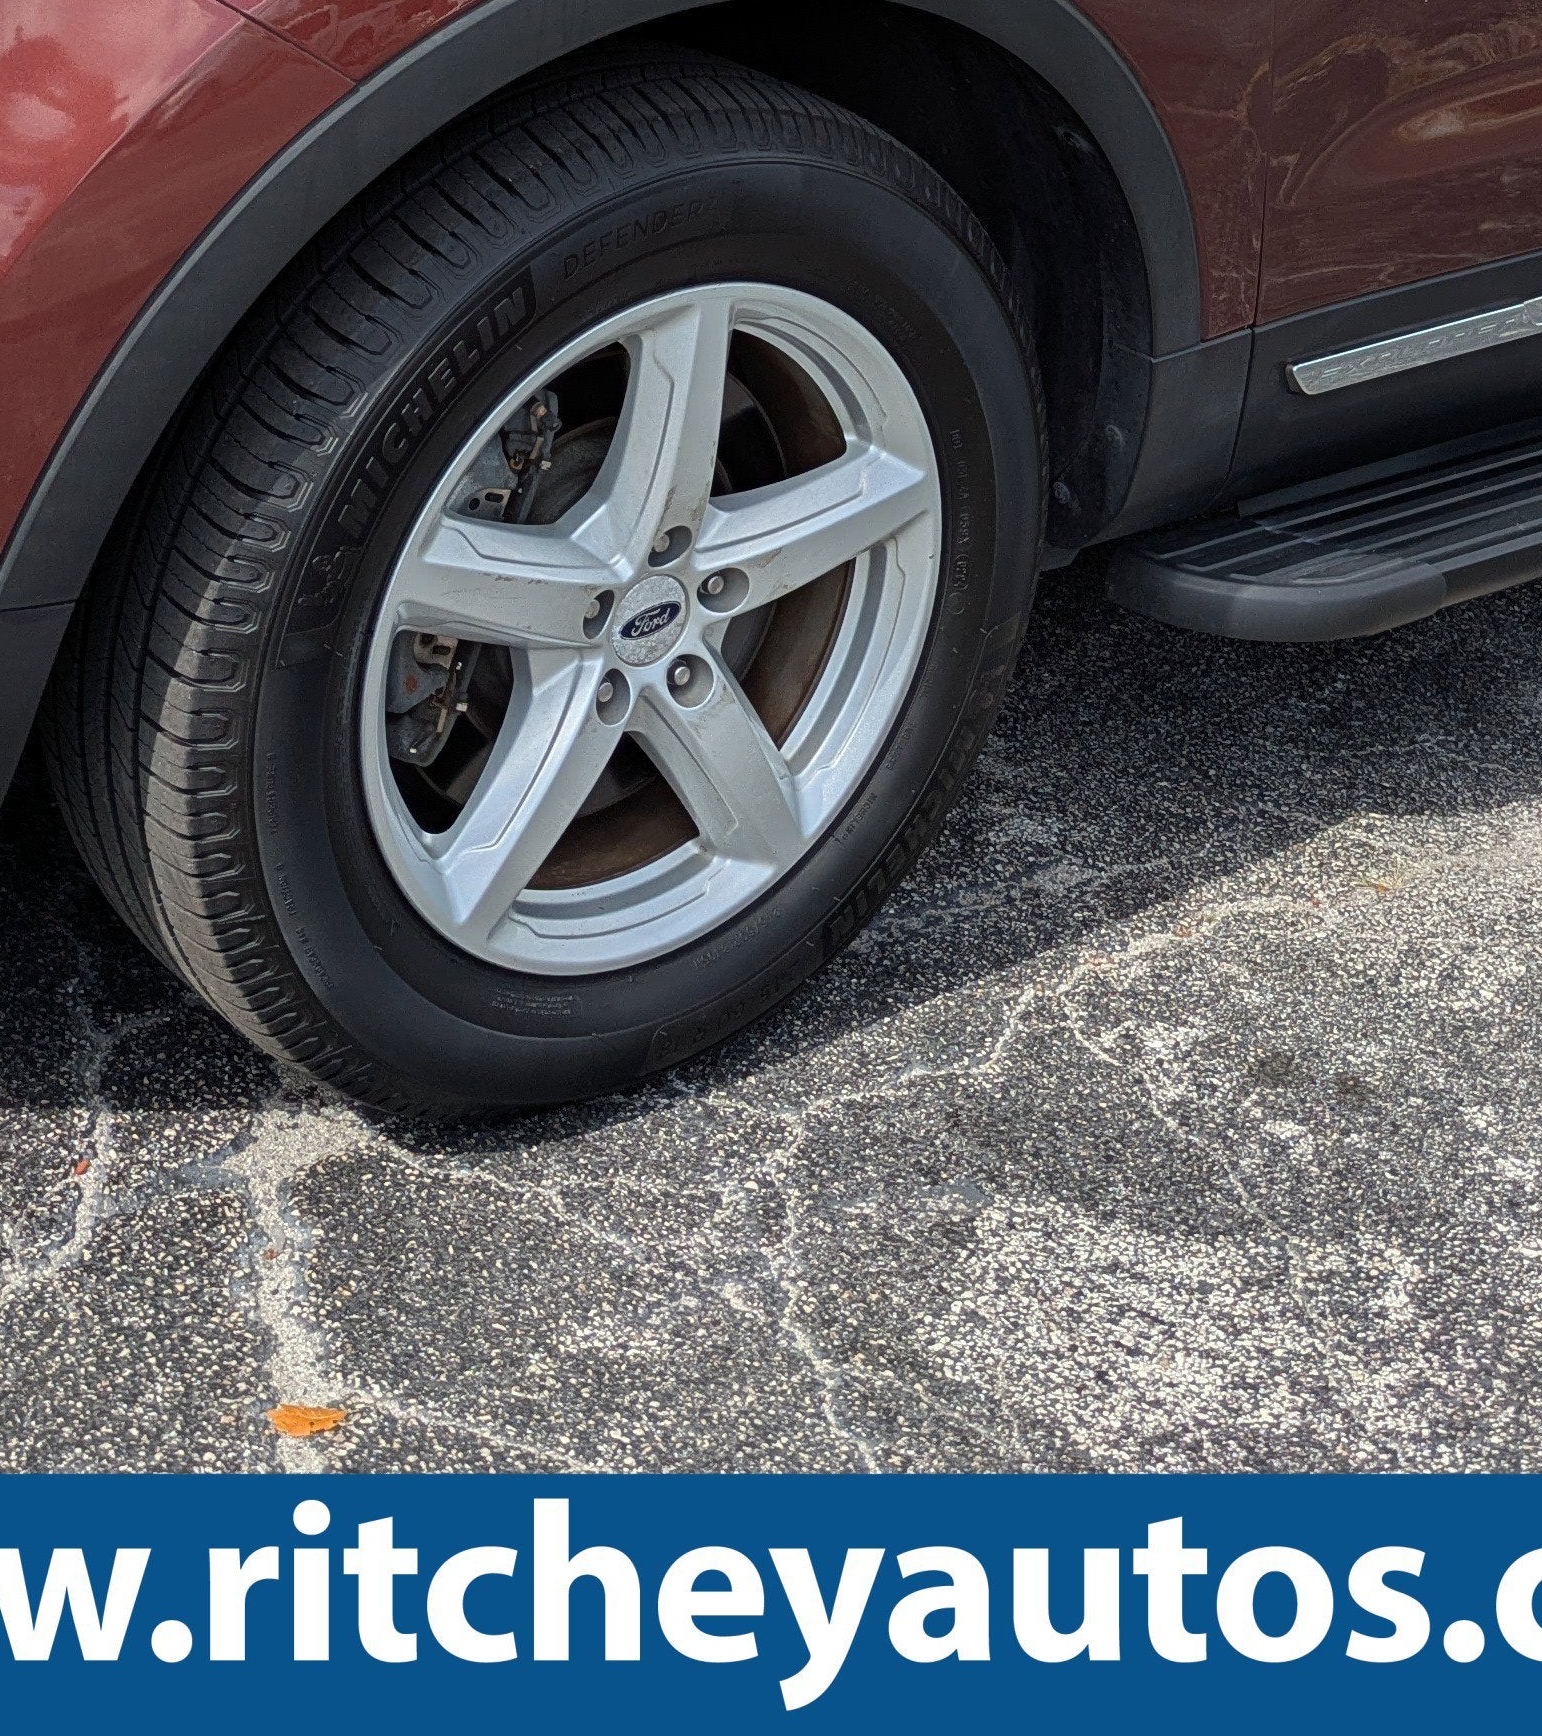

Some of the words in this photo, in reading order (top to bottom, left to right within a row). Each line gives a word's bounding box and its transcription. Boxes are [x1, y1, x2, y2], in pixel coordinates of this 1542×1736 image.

[563, 199, 705, 280] DEFENDER
[337, 285, 527, 539] MICHELIN
[627, 605, 673, 638] Ford
